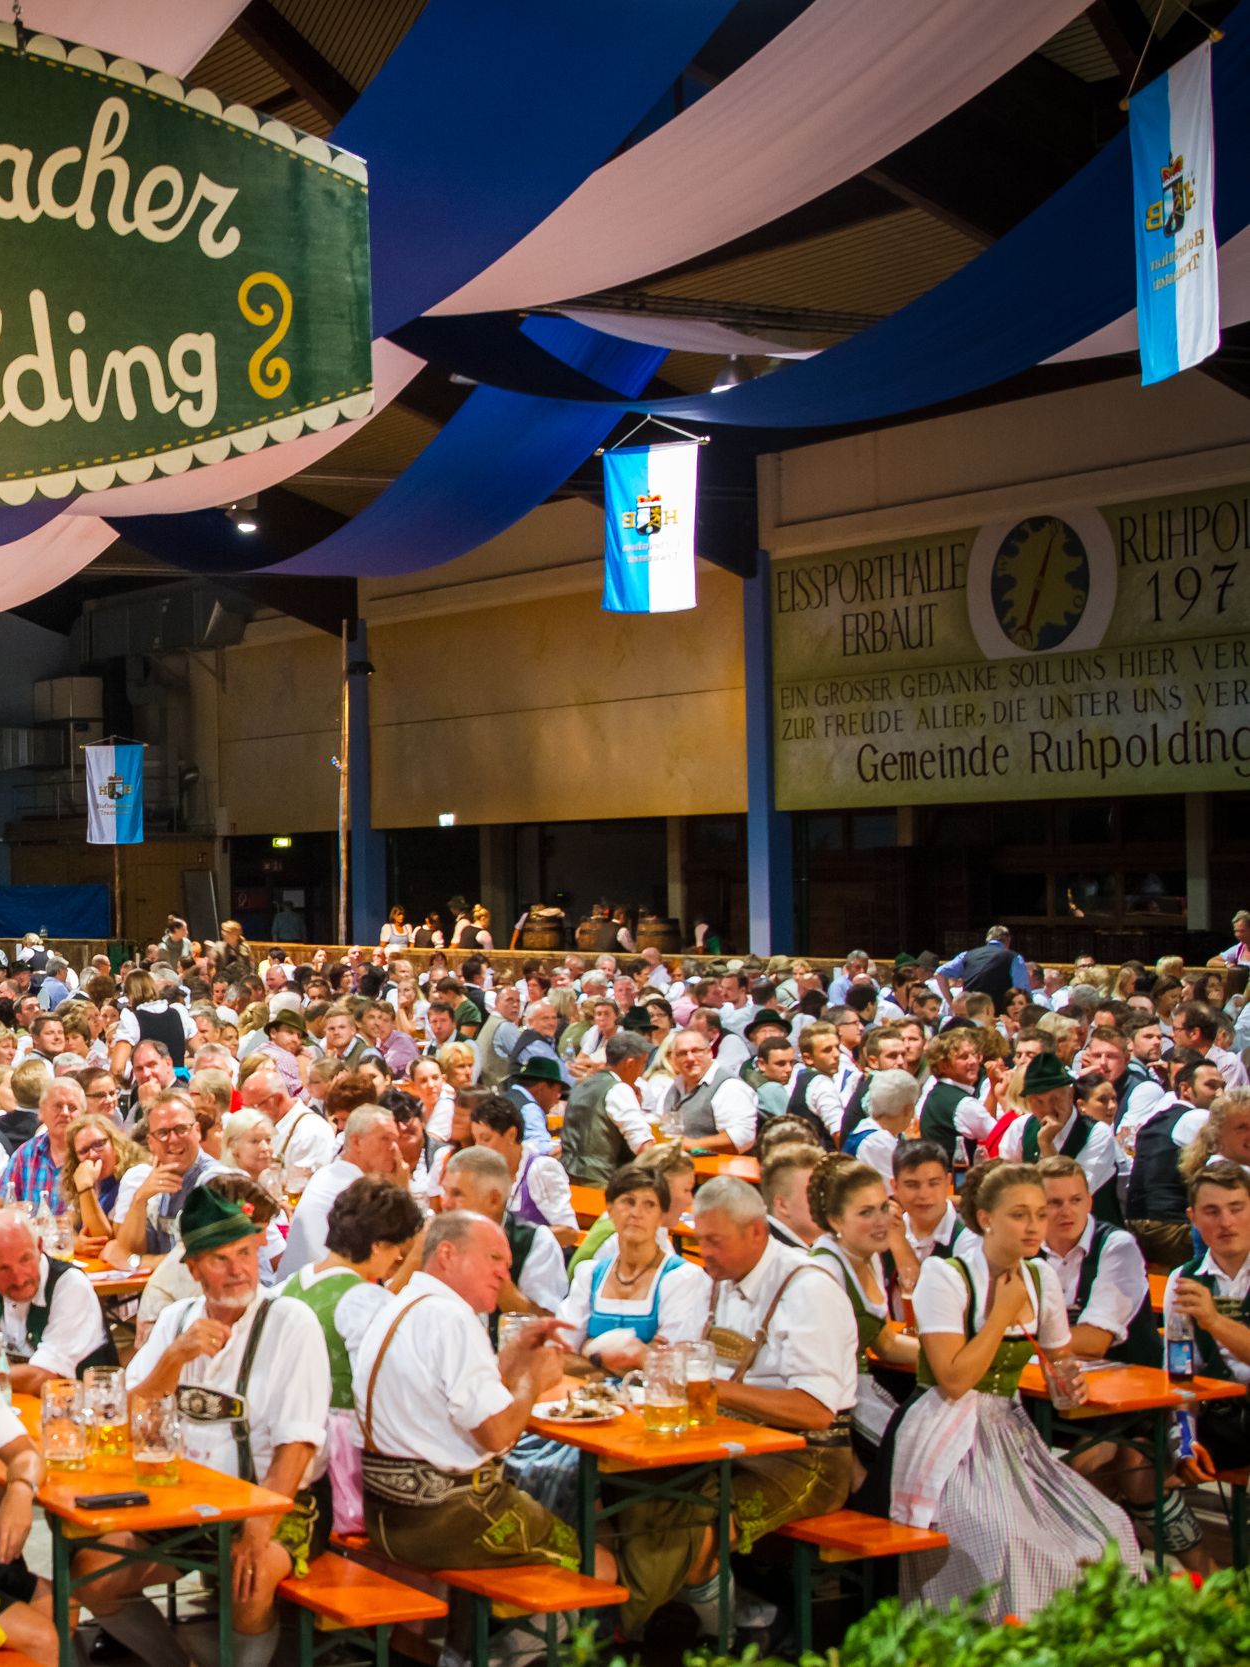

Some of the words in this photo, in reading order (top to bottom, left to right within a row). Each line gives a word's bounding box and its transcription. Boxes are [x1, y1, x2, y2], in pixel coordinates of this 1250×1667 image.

[1119, 498, 1250, 567] RUHPOL
[776, 543, 967, 614] EISSPORTHALLE
[1147, 562, 1238, 622] 197
[842, 603, 938, 657] ERBAUT
[780, 686, 809, 711] EIN
[814, 677, 893, 708] GROSSER
[901, 665, 998, 700] GEDANKE
[1009, 660, 1056, 689] SOLL
[1062, 654, 1106, 685] UNS
[1119, 647, 1178, 679] HIER
[1192, 640, 1250, 672] VER
[781, 716, 816, 741] ZUR
[824, 709, 904, 738] FREUDE
[916, 703, 987, 731] ALLER,
[993, 698, 1027, 725] DIE
[1039, 690, 1121, 721] UNTER
[1133, 685, 1182, 714] UNS
[1195, 679, 1250, 708] VER
[857, 735, 1009, 783] Gemeinde
[1029, 720, 1250, 780] Ruhpolding
